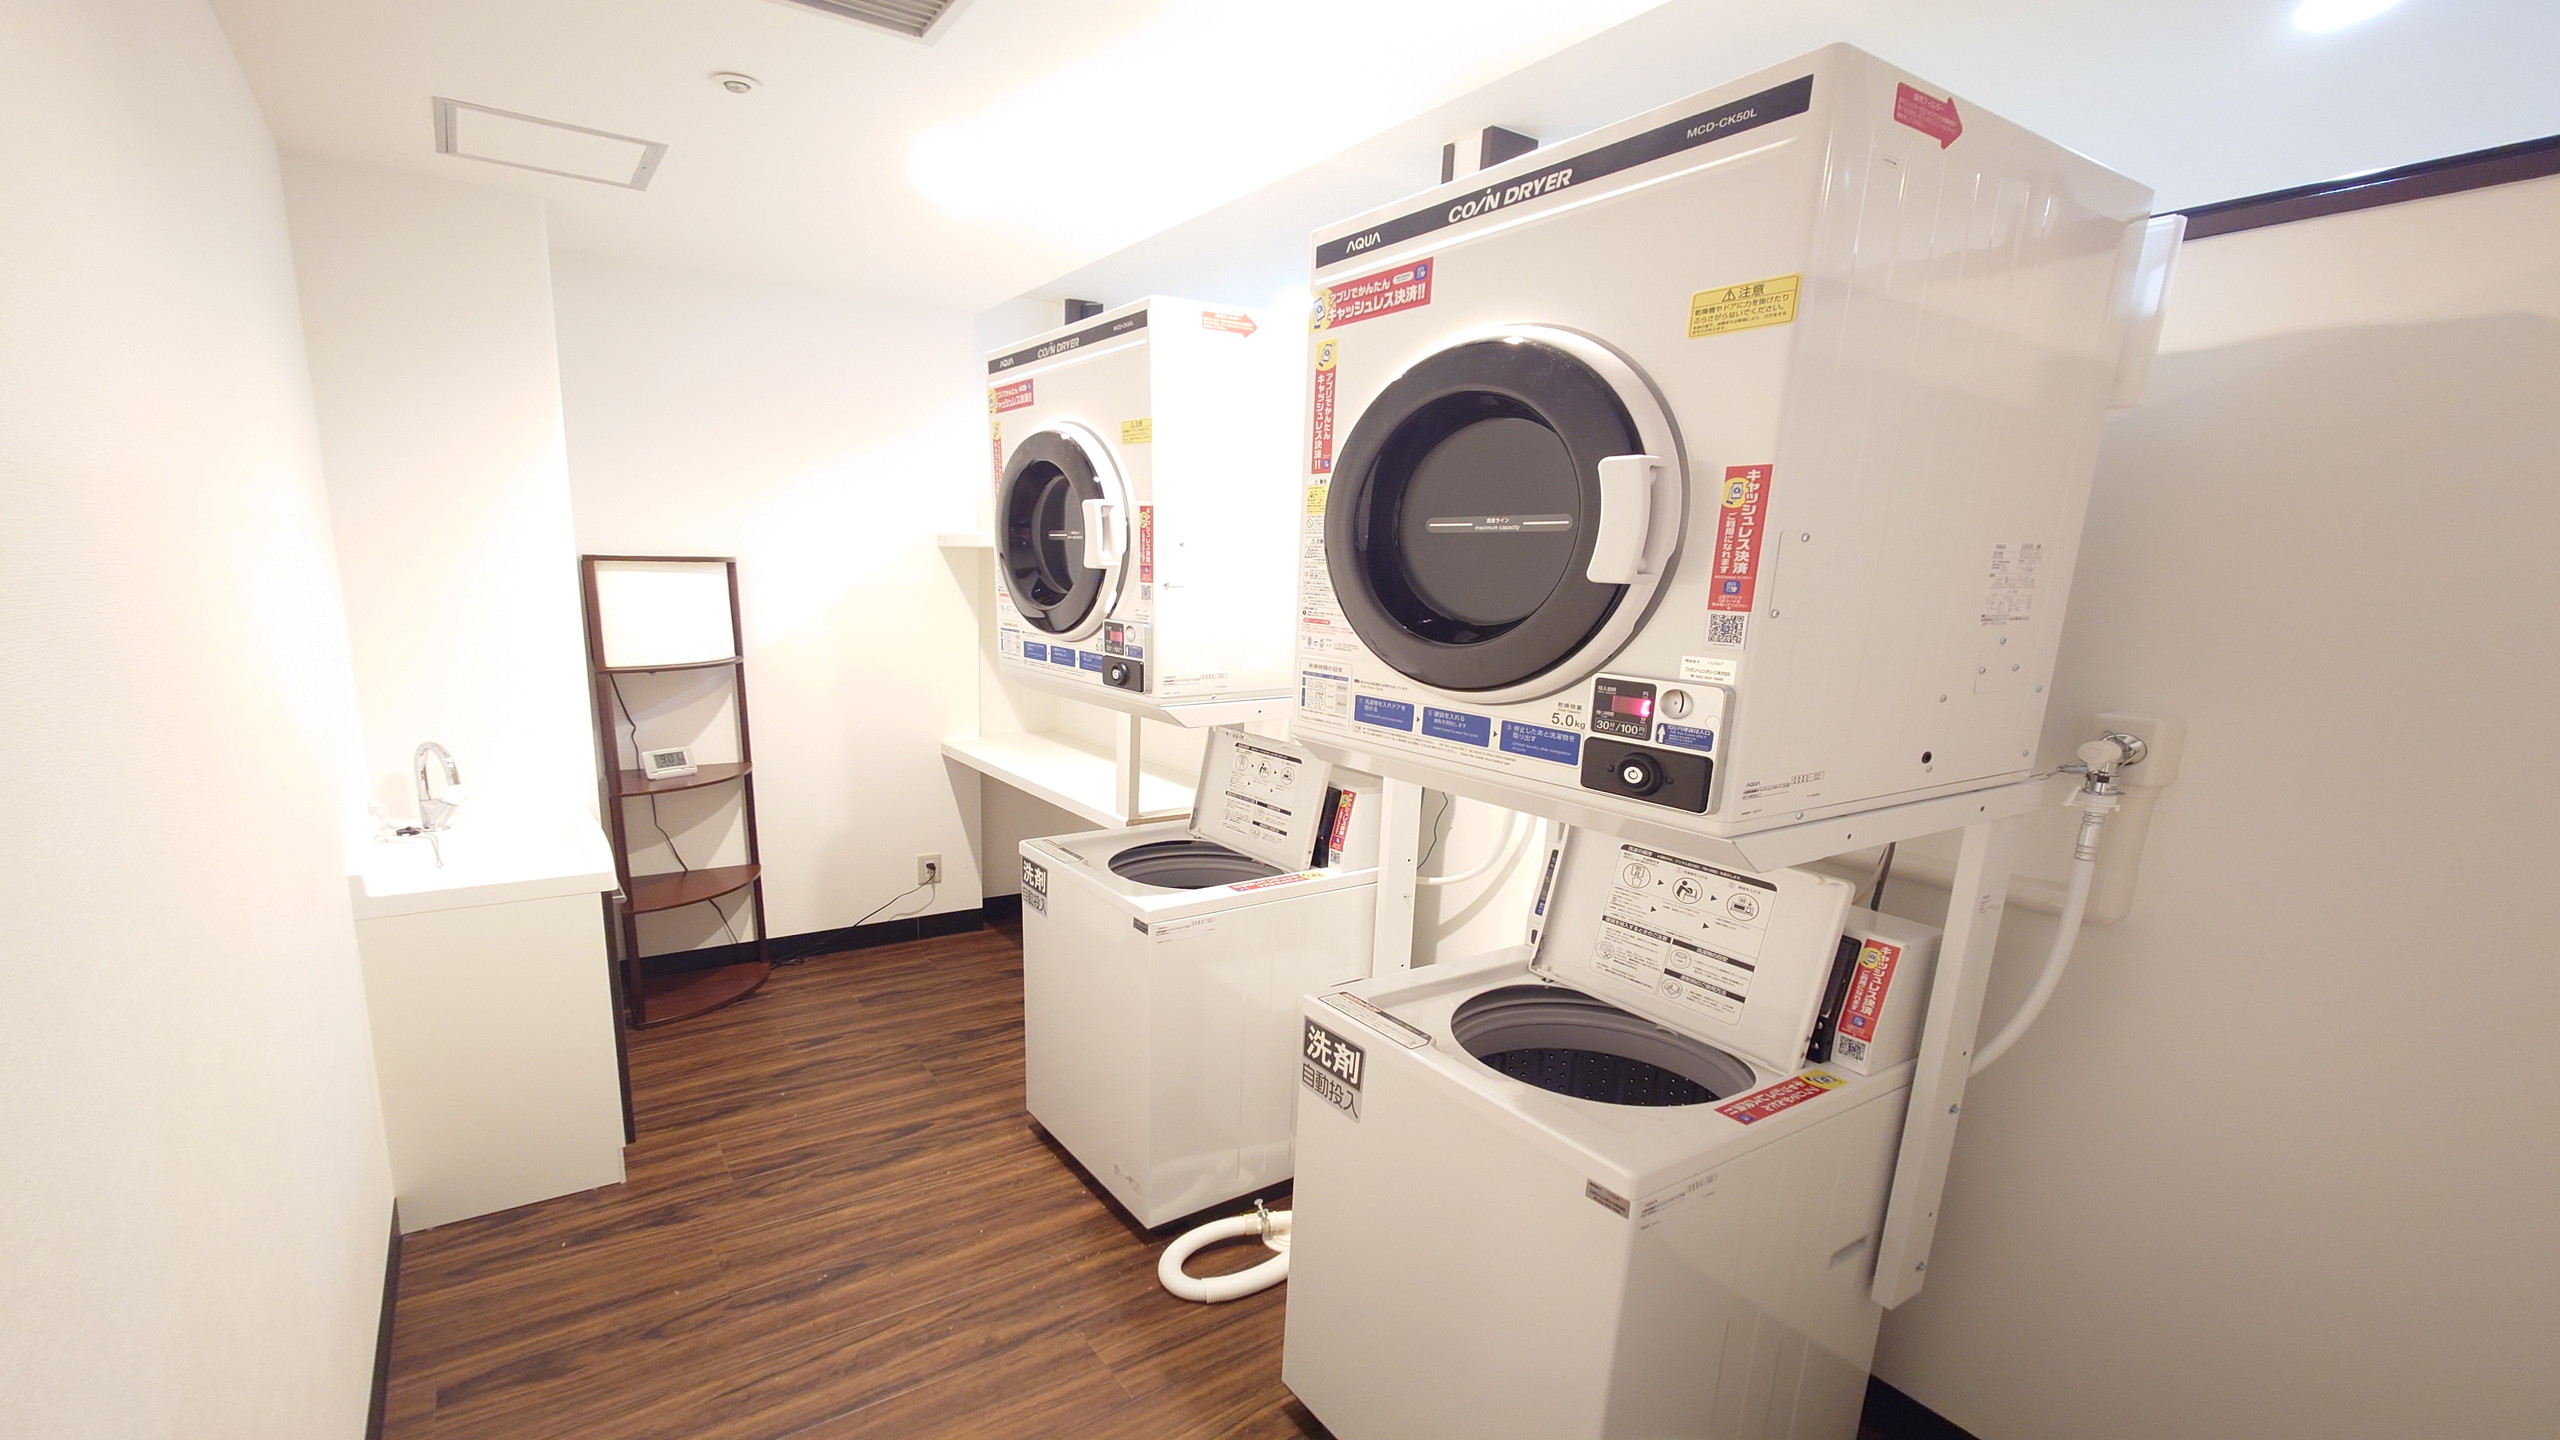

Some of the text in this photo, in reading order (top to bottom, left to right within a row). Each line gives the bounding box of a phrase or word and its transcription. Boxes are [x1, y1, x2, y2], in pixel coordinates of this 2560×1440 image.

[1686, 107, 1758, 140] MCD-CK50L
[1447, 167, 1574, 225] COIN DRYER
[1346, 231, 1381, 254] AQUA
[1329, 278, 1391, 305] アプリでかんたん
[1738, 284, 1765, 299] 注意
[1056, 336, 1080, 353] DRYER
[999, 357, 1014, 368] AQUA
[1323, 373, 1334, 440] アプリでかんたん
[1732, 468, 1762, 575] キャッシュレス決済
[1719, 511, 1738, 574] ご利用になれます
[1433, 710, 1466, 722] 硬貨を入れる
[1512, 732, 1536, 742] 取り出す
[1513, 726, 1576, 743] 停止したあと洗濯物を
[1023, 860, 1046, 893] 洗剤
[1861, 946, 1892, 1016] キャッシュレス決済
[1306, 1025, 1361, 1084] 洗剤
[1302, 1062, 1359, 1120] 自動投入
